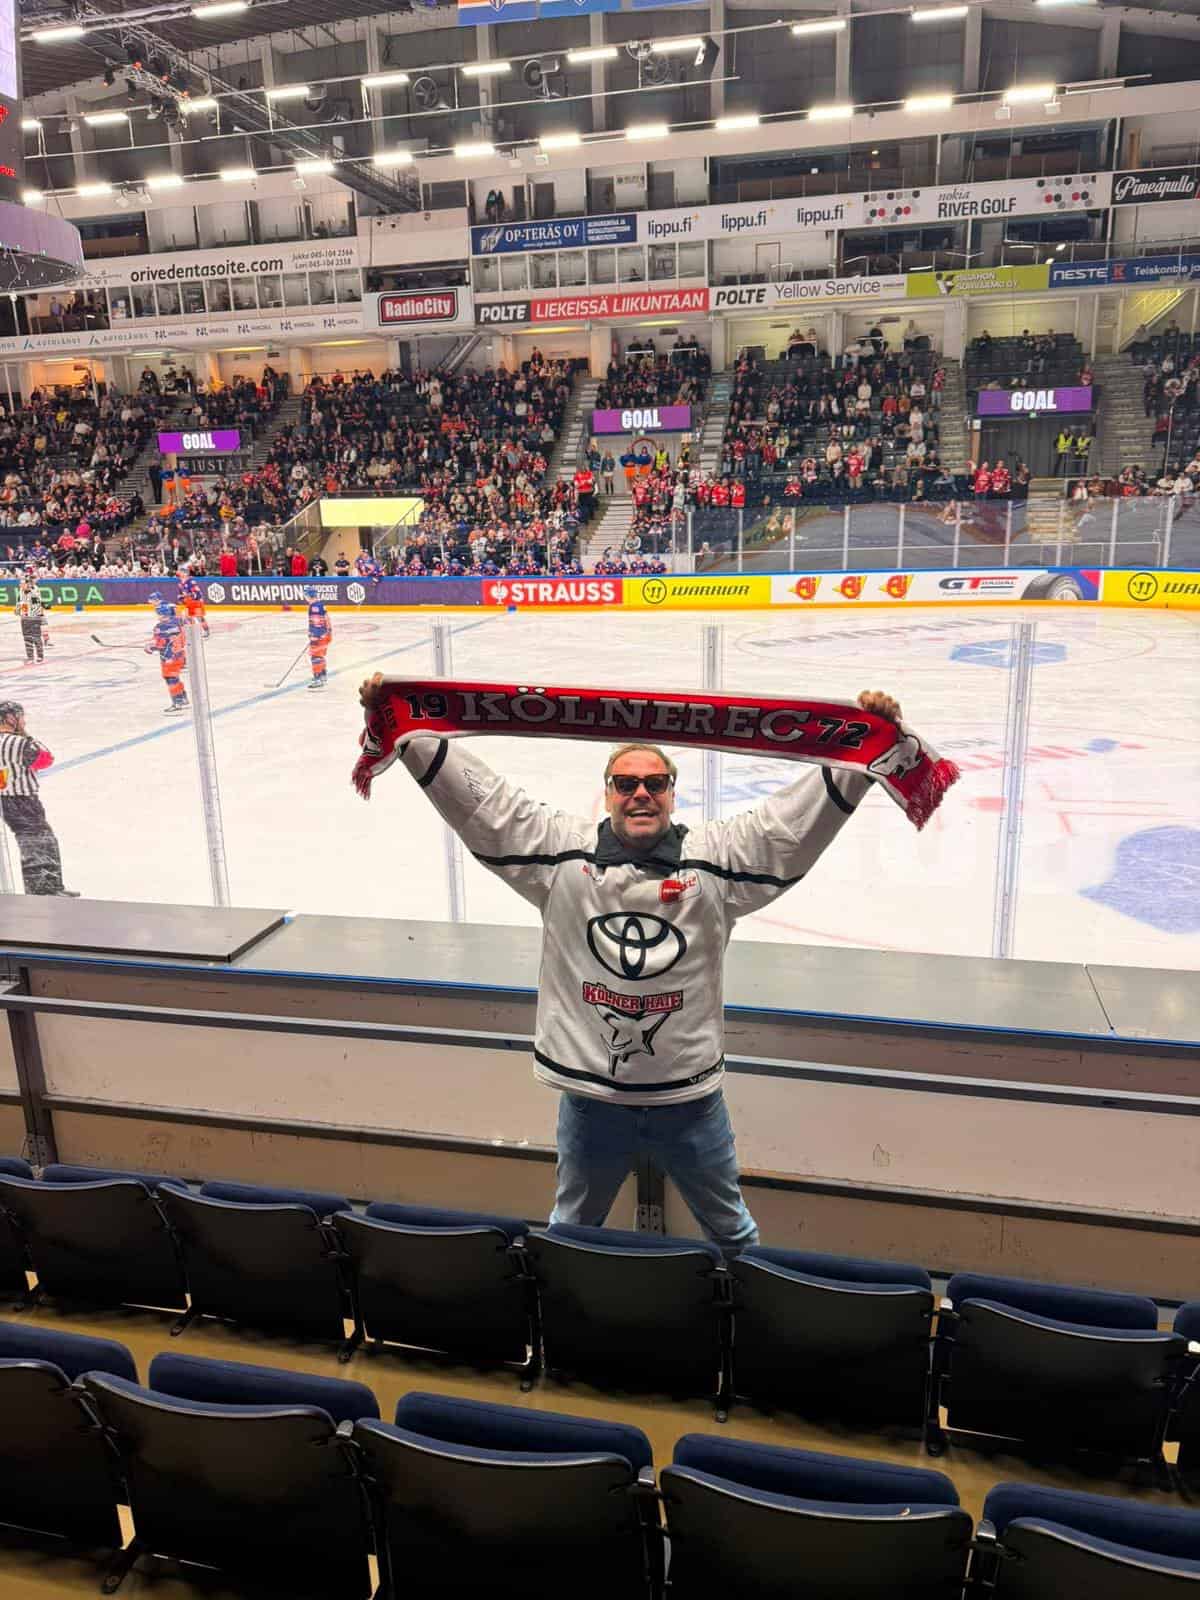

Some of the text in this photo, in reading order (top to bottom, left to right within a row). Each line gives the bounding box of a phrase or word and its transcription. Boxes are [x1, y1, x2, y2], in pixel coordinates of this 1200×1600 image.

[797, 205, 844, 226] lippu.fi
[938, 197, 1017, 218] RIVER GOLF
[648, 217, 692, 237] lippu.fi
[721, 211, 767, 232] lippu.fi
[505, 224, 561, 243] OP-TERÄS
[563, 223, 580, 237] OY
[130, 258, 284, 282] orivedentasoite.com
[1053, 267, 1108, 280] NESTE
[715, 280, 881, 306] POLTE Yellow Service
[385, 297, 451, 318] RadioCity
[480, 292, 704, 322] POLTE LIEKEISSÄ LIIKUNTAAN
[1010, 390, 1057, 410] GOAL
[622, 408, 662, 429] GOAL
[182, 432, 216, 449] GOAL
[511, 582, 615, 602] STRAUSS
[671, 585, 750, 596] WARRIOR
[403, 692, 449, 720] 19
[816, 718, 872, 750] 72
